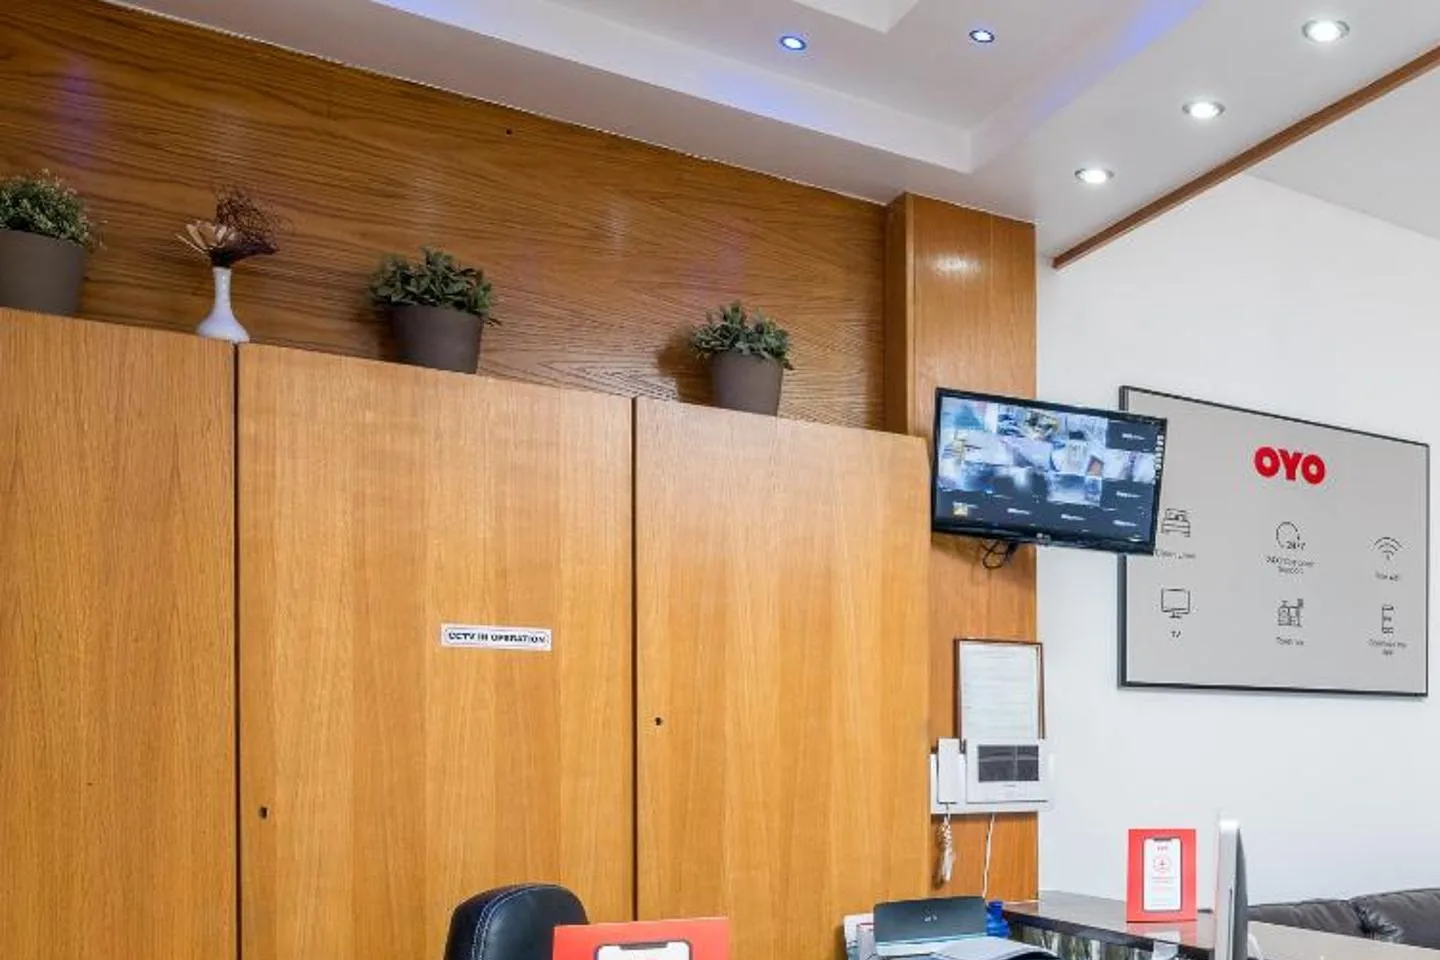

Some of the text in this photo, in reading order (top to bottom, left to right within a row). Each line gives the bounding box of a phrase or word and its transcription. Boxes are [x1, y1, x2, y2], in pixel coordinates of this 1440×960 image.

[1254, 446, 1326, 485] OYO
[448, 632, 546, 643] CCTV IN OPERATION
